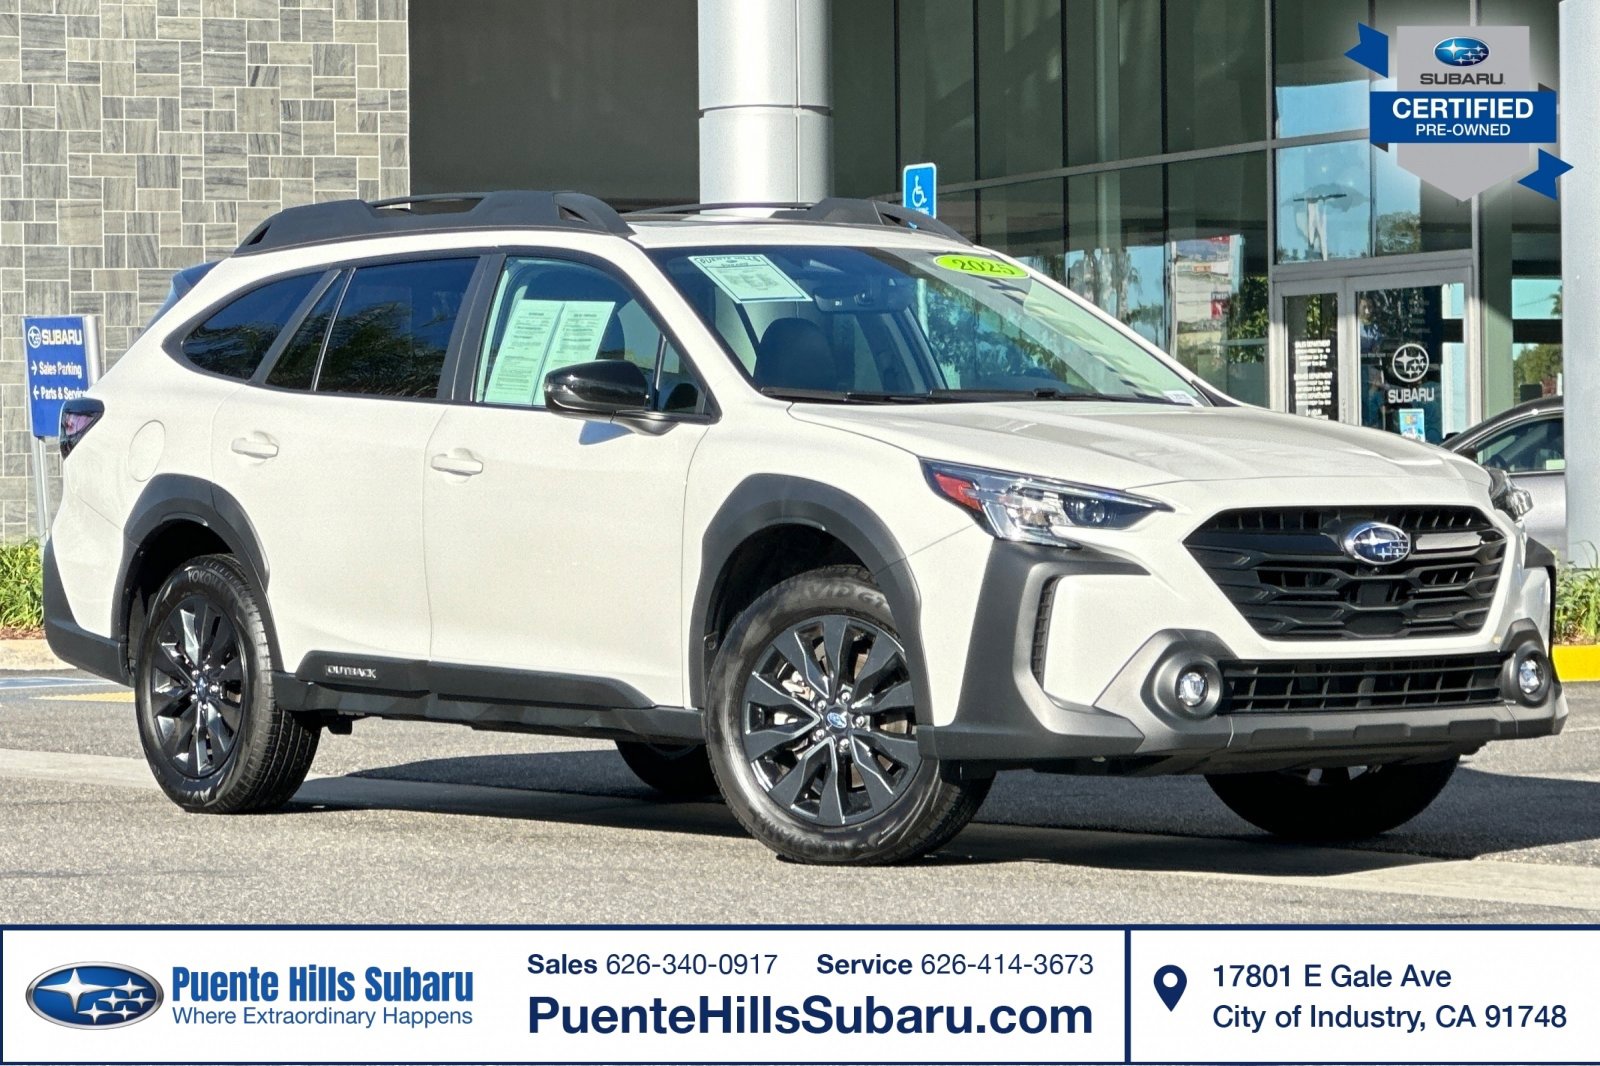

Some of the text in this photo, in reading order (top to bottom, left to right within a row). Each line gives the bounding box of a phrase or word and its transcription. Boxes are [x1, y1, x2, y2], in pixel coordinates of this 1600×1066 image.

[951, 259, 1015, 275] 2025
[41, 328, 83, 345] SUBARU
[39, 361, 83, 379] Sales Parking
[41, 386, 57, 400] Parts
[58, 388, 63, 400] &
[1387, 387, 1435, 403] SUBARU
[327, 665, 377, 679] OUTBACK
